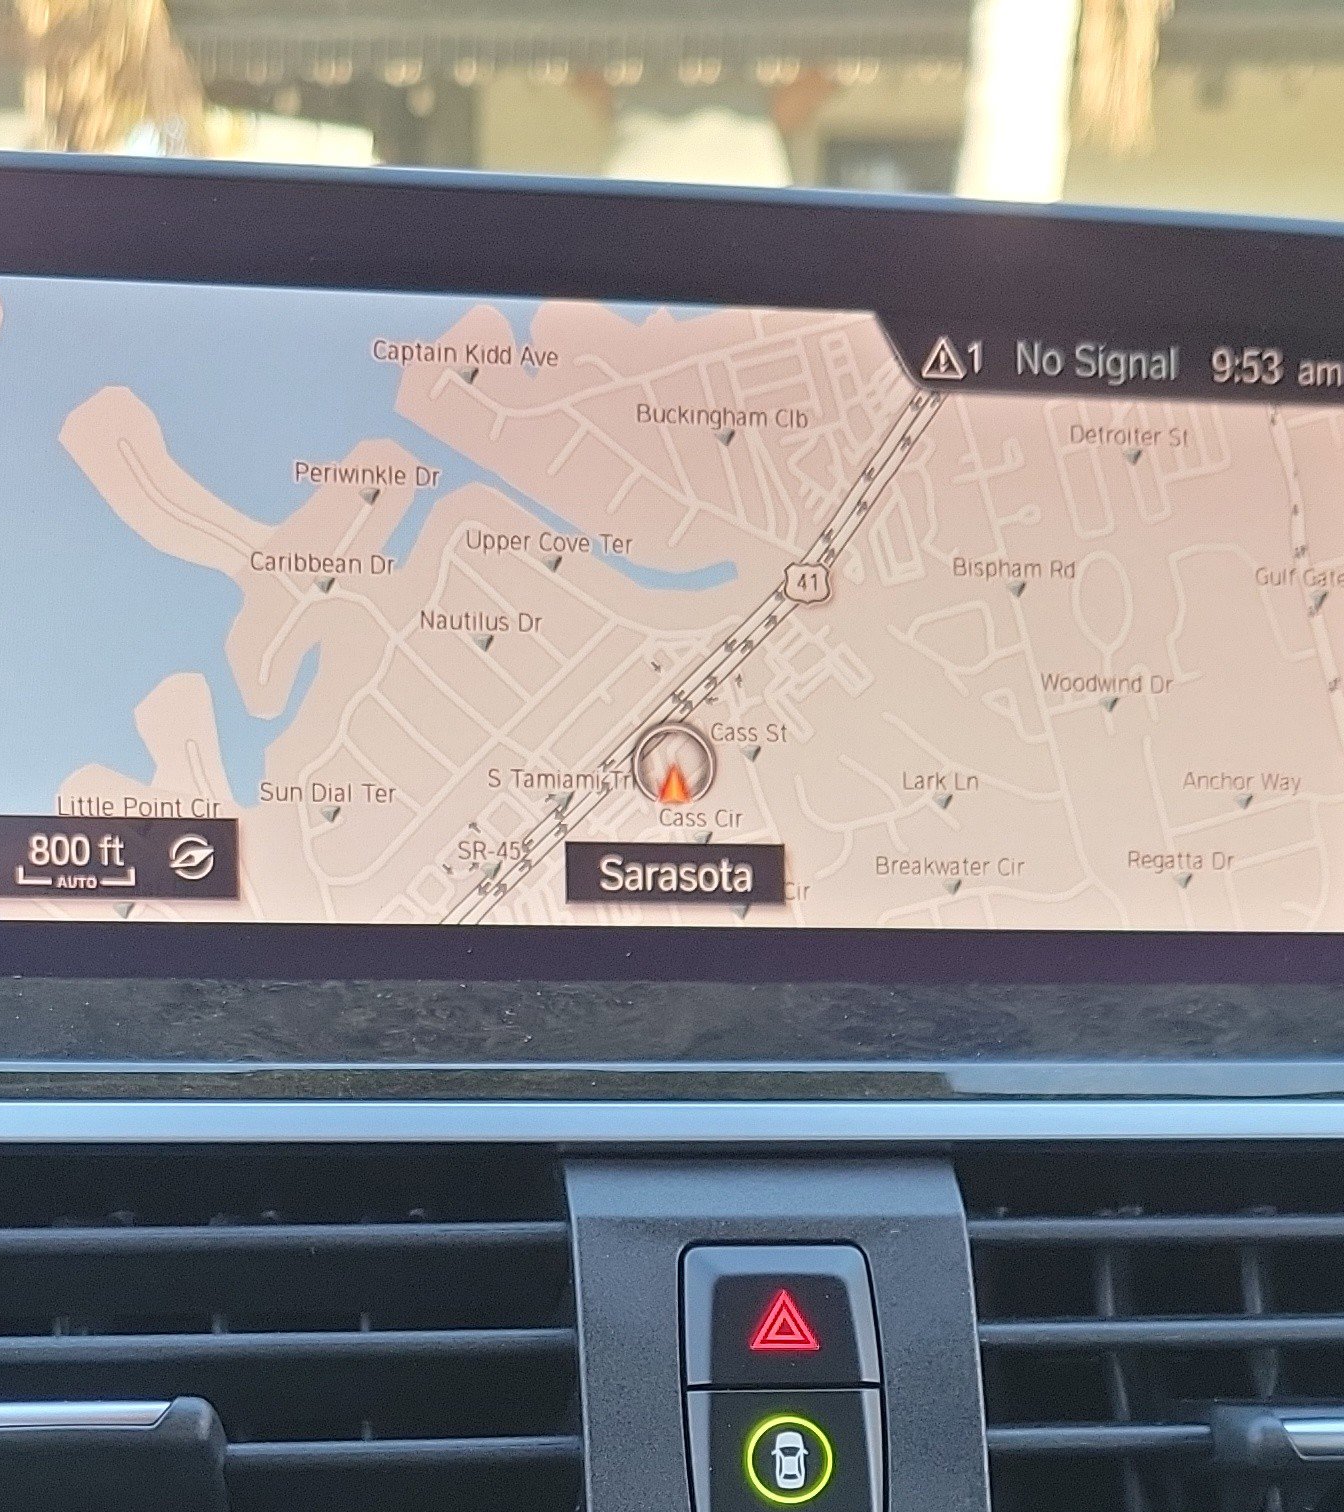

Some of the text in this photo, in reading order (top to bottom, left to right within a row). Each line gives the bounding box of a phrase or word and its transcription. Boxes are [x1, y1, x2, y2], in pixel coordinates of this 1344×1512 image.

[373, 340, 558, 367] Captain Kidd Ave
[1016, 340, 1064, 376] No
[1075, 343, 1178, 386] Signal
[1211, 347, 1284, 385] 9:53
[636, 404, 808, 431] Buckingham Clb
[1170, 429, 1189, 447] St
[295, 462, 440, 487] Periwinkle Dr
[466, 530, 633, 557] Upper Cove Ter
[250, 552, 395, 576] Caribbean Dr
[953, 557, 1076, 583] Bispham Rd
[797, 573, 817, 592] 41
[1255, 567, 1296, 586] Gulf
[420, 612, 543, 634] Nautilus Dr
[1040, 673, 1174, 695] Woodwind Dr
[710, 722, 788, 744] Cass St
[488, 770, 501, 788] S
[510, 770, 601, 791] Tamiami
[902, 772, 979, 791] Lark Ln
[1183, 772, 1302, 796] Anchor Way
[260, 783, 396, 805] Sun Dial Ter
[58, 796, 222, 819] Little Point Cir
[659, 808, 743, 828] Cass Cir
[29, 833, 125, 867] 800 ft
[458, 841, 521, 861] SR-45
[875, 857, 1026, 878] Breakwater Cir
[1128, 851, 1235, 875] Regatta Dr
[57, 874, 98, 889] AUTO
[600, 856, 754, 893] Sarasota
